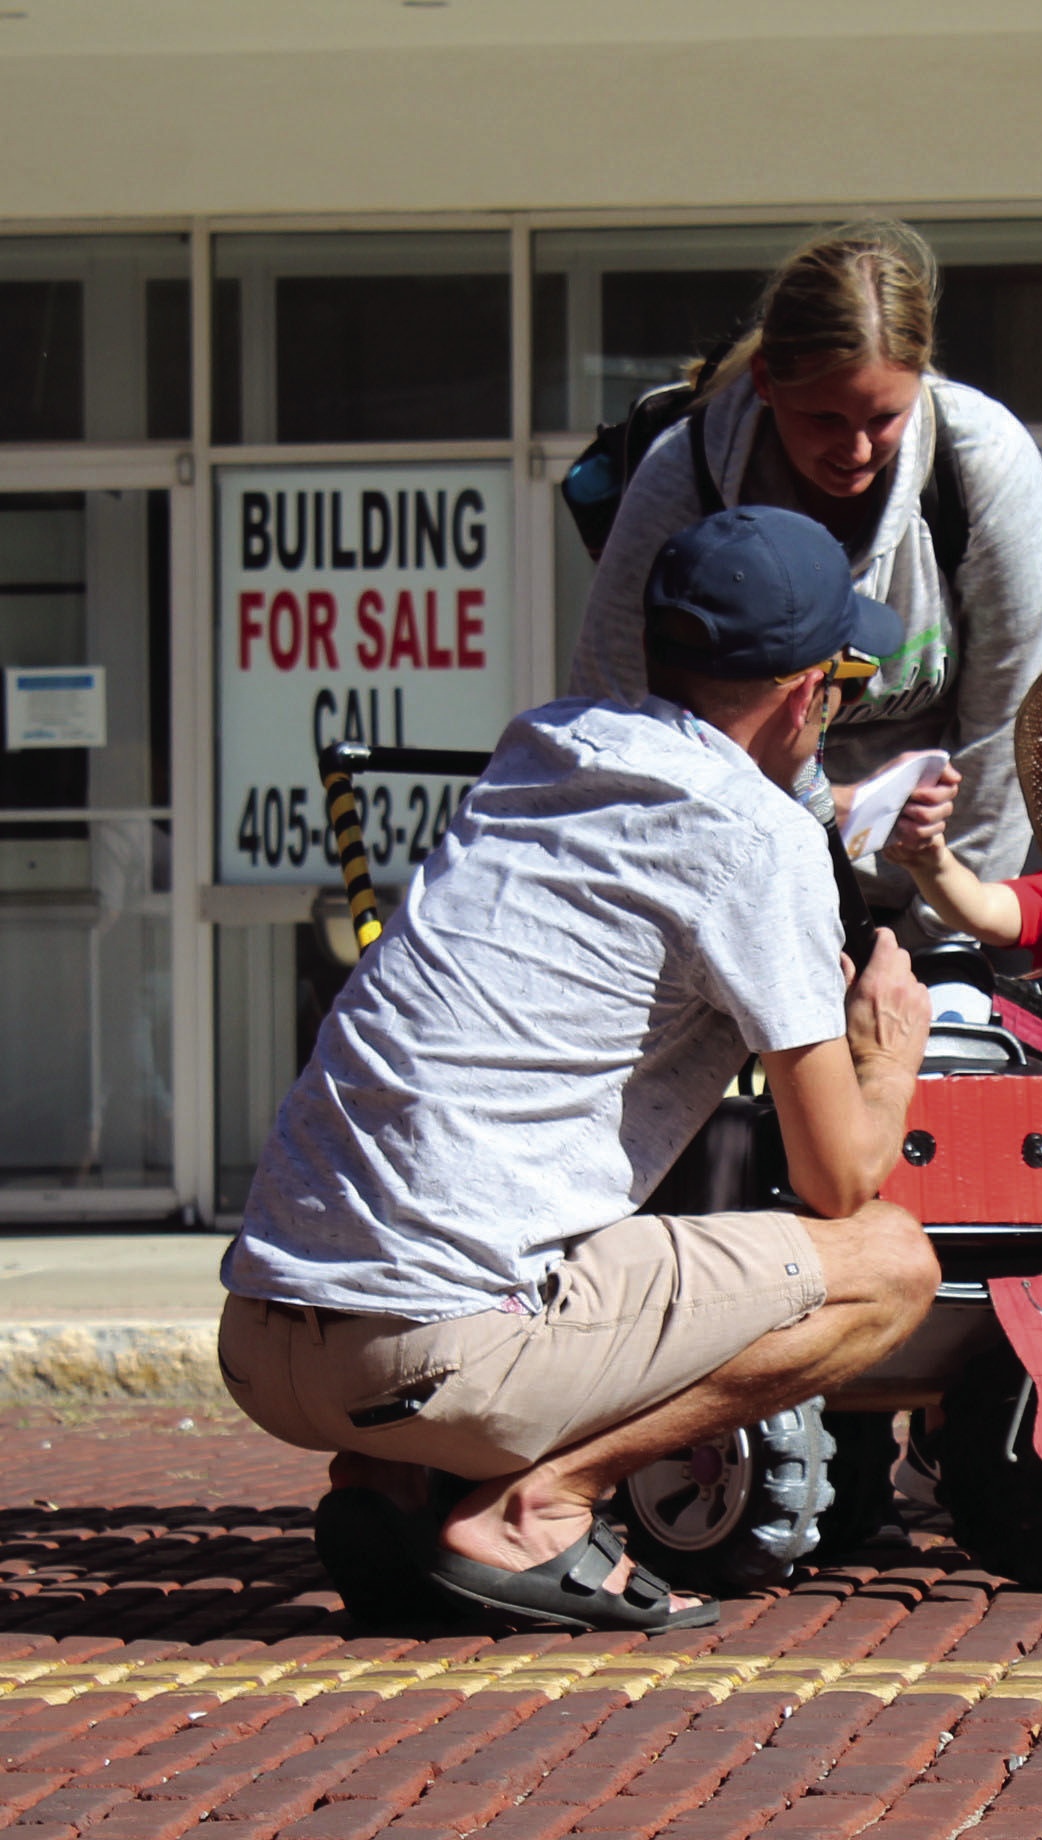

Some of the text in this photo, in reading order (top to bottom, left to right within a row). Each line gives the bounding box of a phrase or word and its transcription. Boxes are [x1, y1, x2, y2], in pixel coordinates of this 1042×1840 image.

[242, 489, 487, 571] BUILDING
[239, 588, 487, 671] FOR SALE
